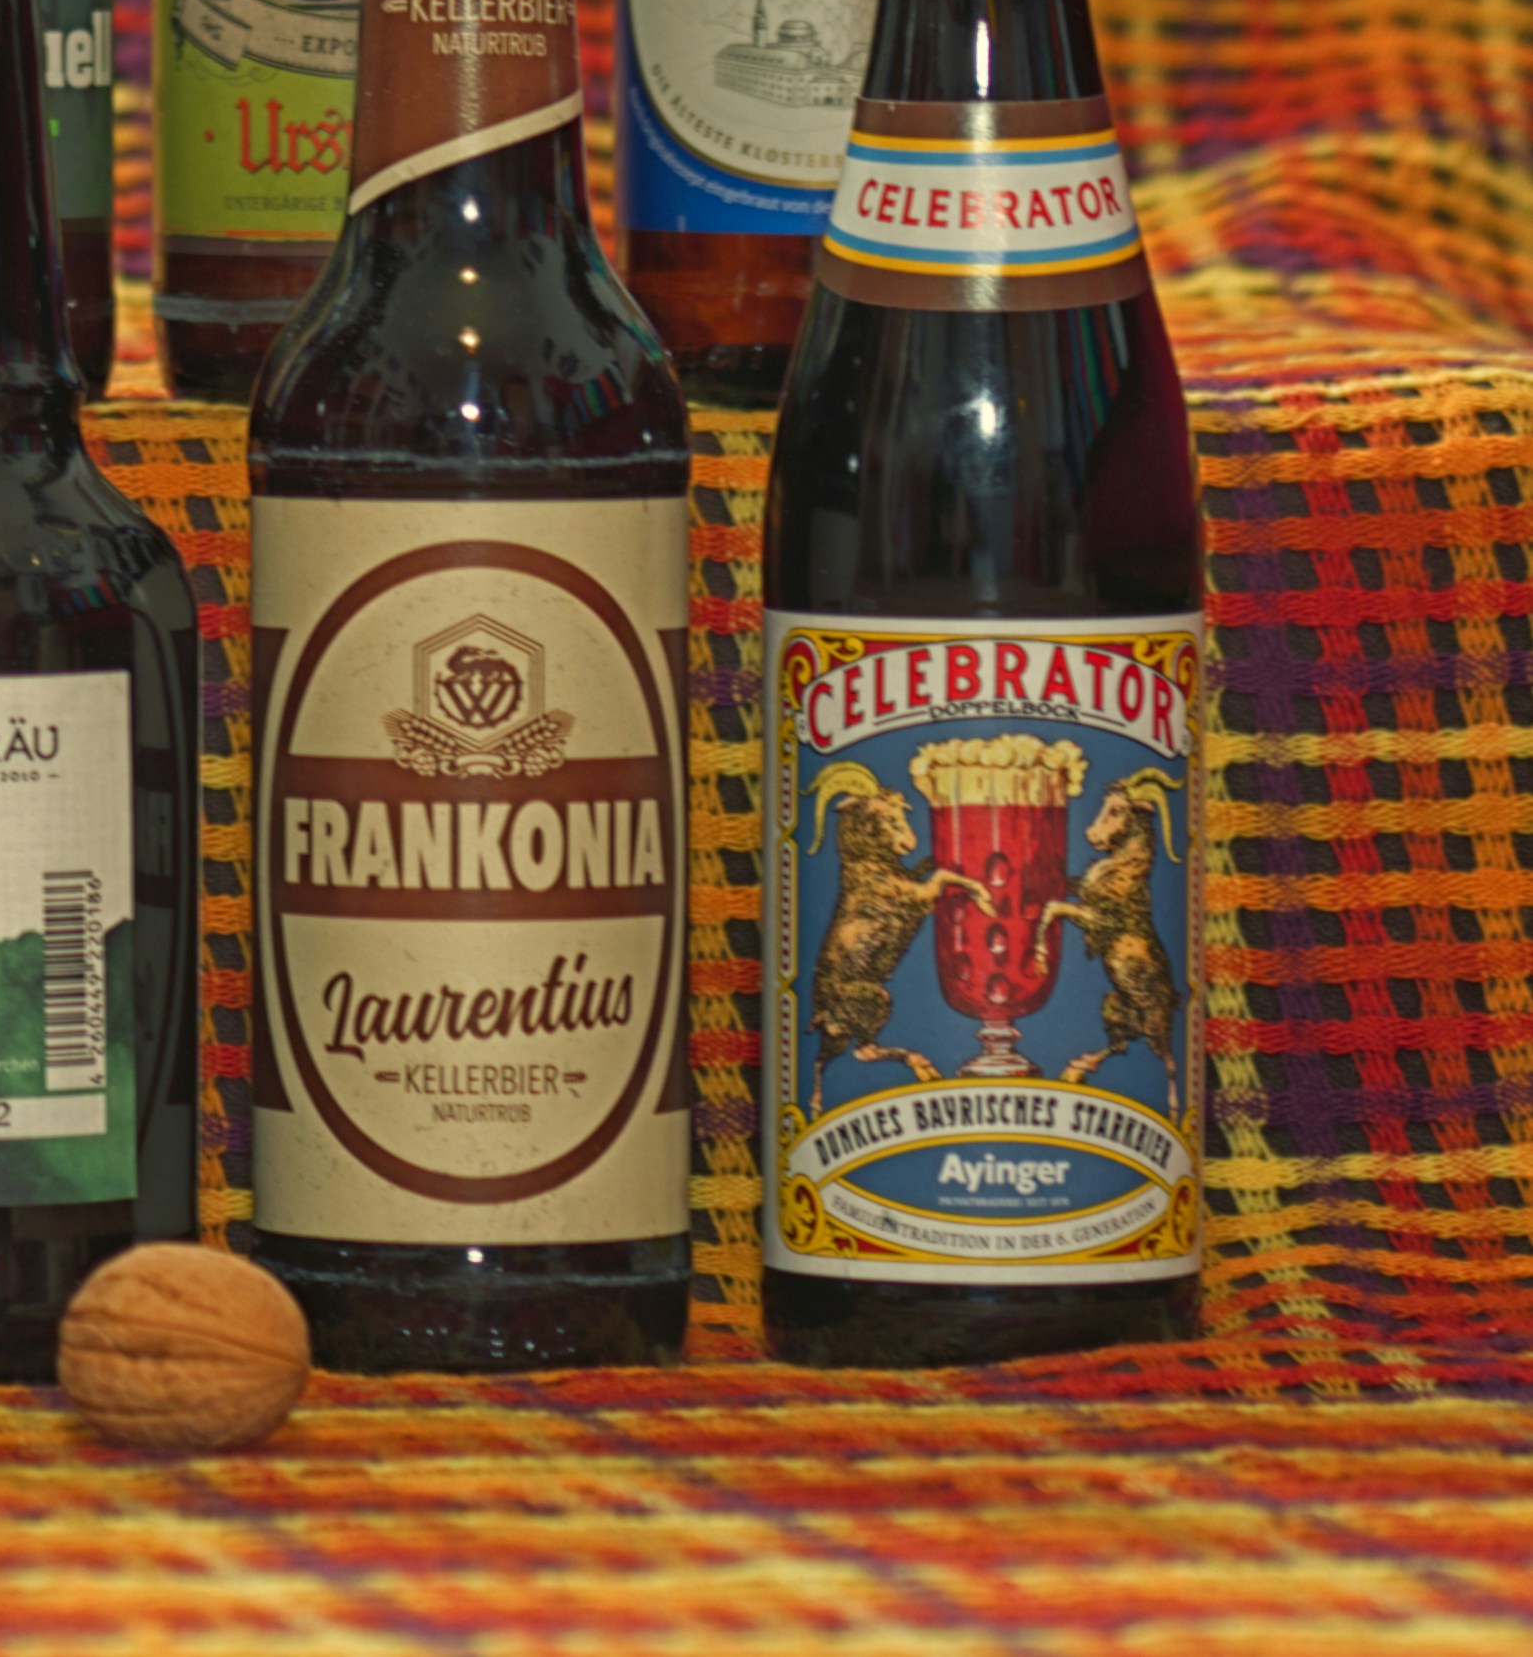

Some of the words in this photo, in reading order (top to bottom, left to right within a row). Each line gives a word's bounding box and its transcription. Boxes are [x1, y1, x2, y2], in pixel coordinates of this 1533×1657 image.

[432, 26, 547, 57] NATURTRÜB
[669, 94, 735, 150] ÄLTESTE
[857, 176, 1123, 230] CELEBRATOR
[806, 642, 1178, 753] CELEBRATOR
[928, 698, 1081, 722] DOPPELBOCK
[282, 796, 666, 893] FRANKONIA
[321, 952, 634, 1062] Laurentius
[404, 1063, 561, 1096] KELLERBIER
[431, 1100, 532, 1124] NATURTRÜB
[813, 1105, 905, 1167] DUNKLES
[911, 1093, 1059, 1133] BAYRISCHES
[1068, 1100, 1174, 1170] STARKBIER
[938, 1152, 1071, 1196] Ayinger
[995, 1234, 1018, 1251] IN
[1020, 1233, 1054, 1251] DER
[1071, 1200, 1159, 1247] GENERATION
